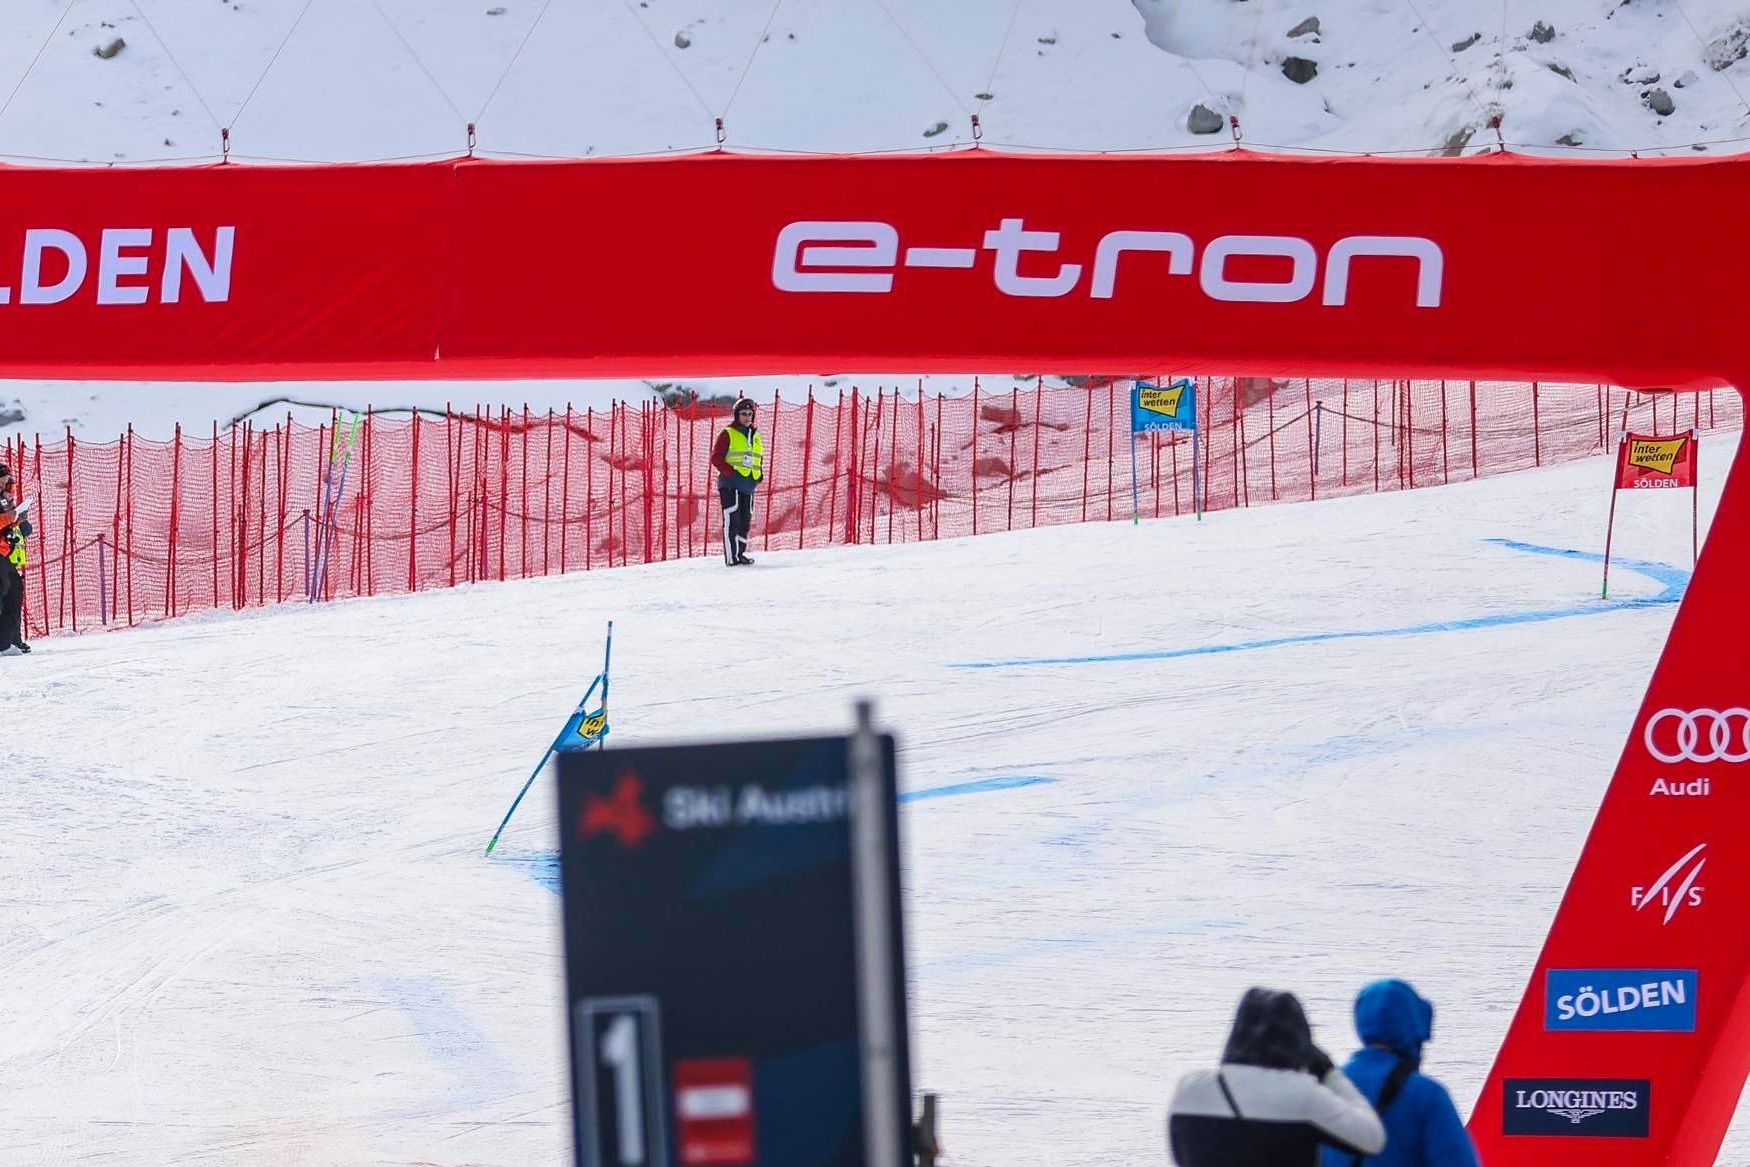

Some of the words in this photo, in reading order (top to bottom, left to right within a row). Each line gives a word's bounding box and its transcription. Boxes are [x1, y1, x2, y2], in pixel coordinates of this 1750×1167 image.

[772, 218, 1443, 308] e-tron
[1141, 389, 1162, 399] inter
[1143, 398, 1176, 407] wetten
[1144, 421, 1183, 431] SÖLDEN
[1633, 441, 1662, 454] inter
[1636, 453, 1674, 463] wetten
[1634, 477, 1679, 488] SÖLDEN
[1649, 777, 1711, 796] Audi
[1557, 979, 1686, 1020] SÖLDEN
[599, 1012, 647, 1167] 1
[1515, 1089, 1638, 1110] LONGINES
